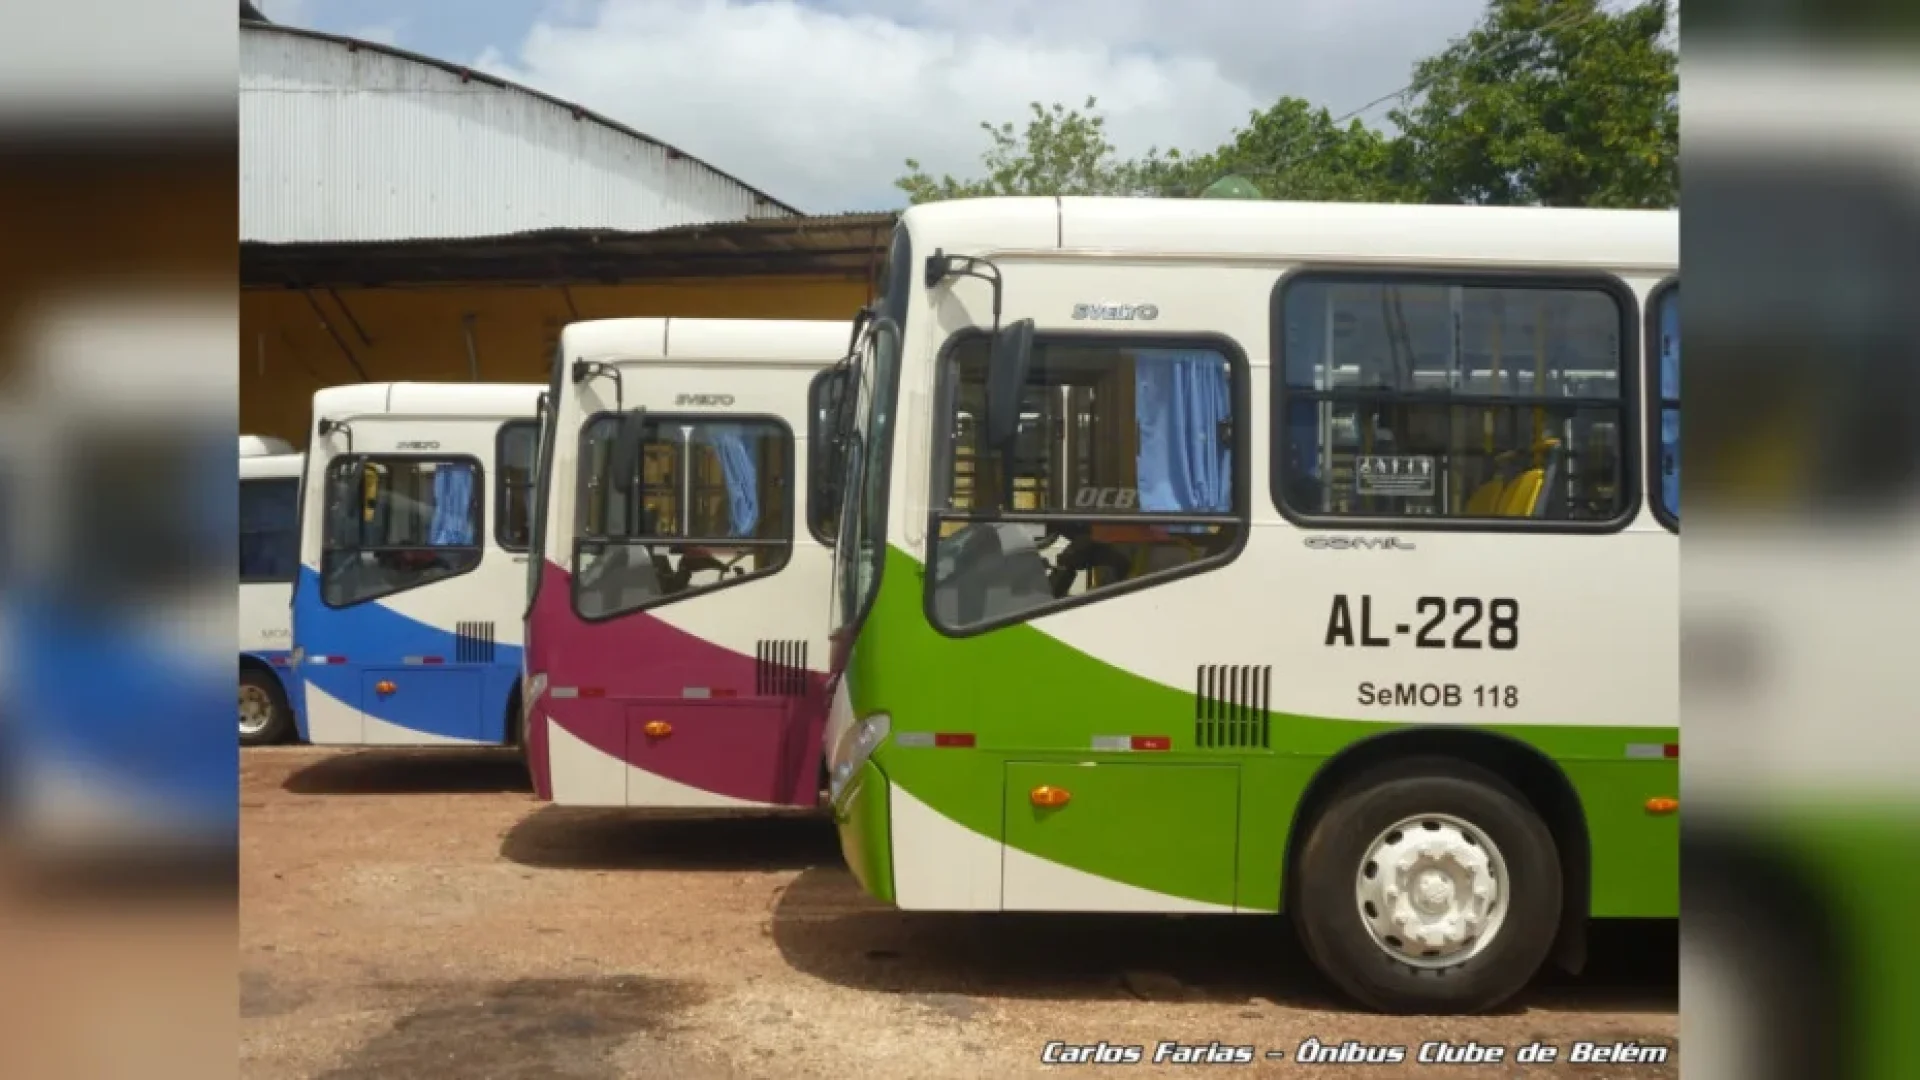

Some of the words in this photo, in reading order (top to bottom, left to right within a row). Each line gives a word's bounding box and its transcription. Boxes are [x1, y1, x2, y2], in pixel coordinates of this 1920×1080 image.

[1072, 303, 1158, 321] SVELTO
[1325, 594, 1519, 649] AL-228
[1358, 682, 1462, 707] SeMOB
[1473, 685, 1519, 708] 118
